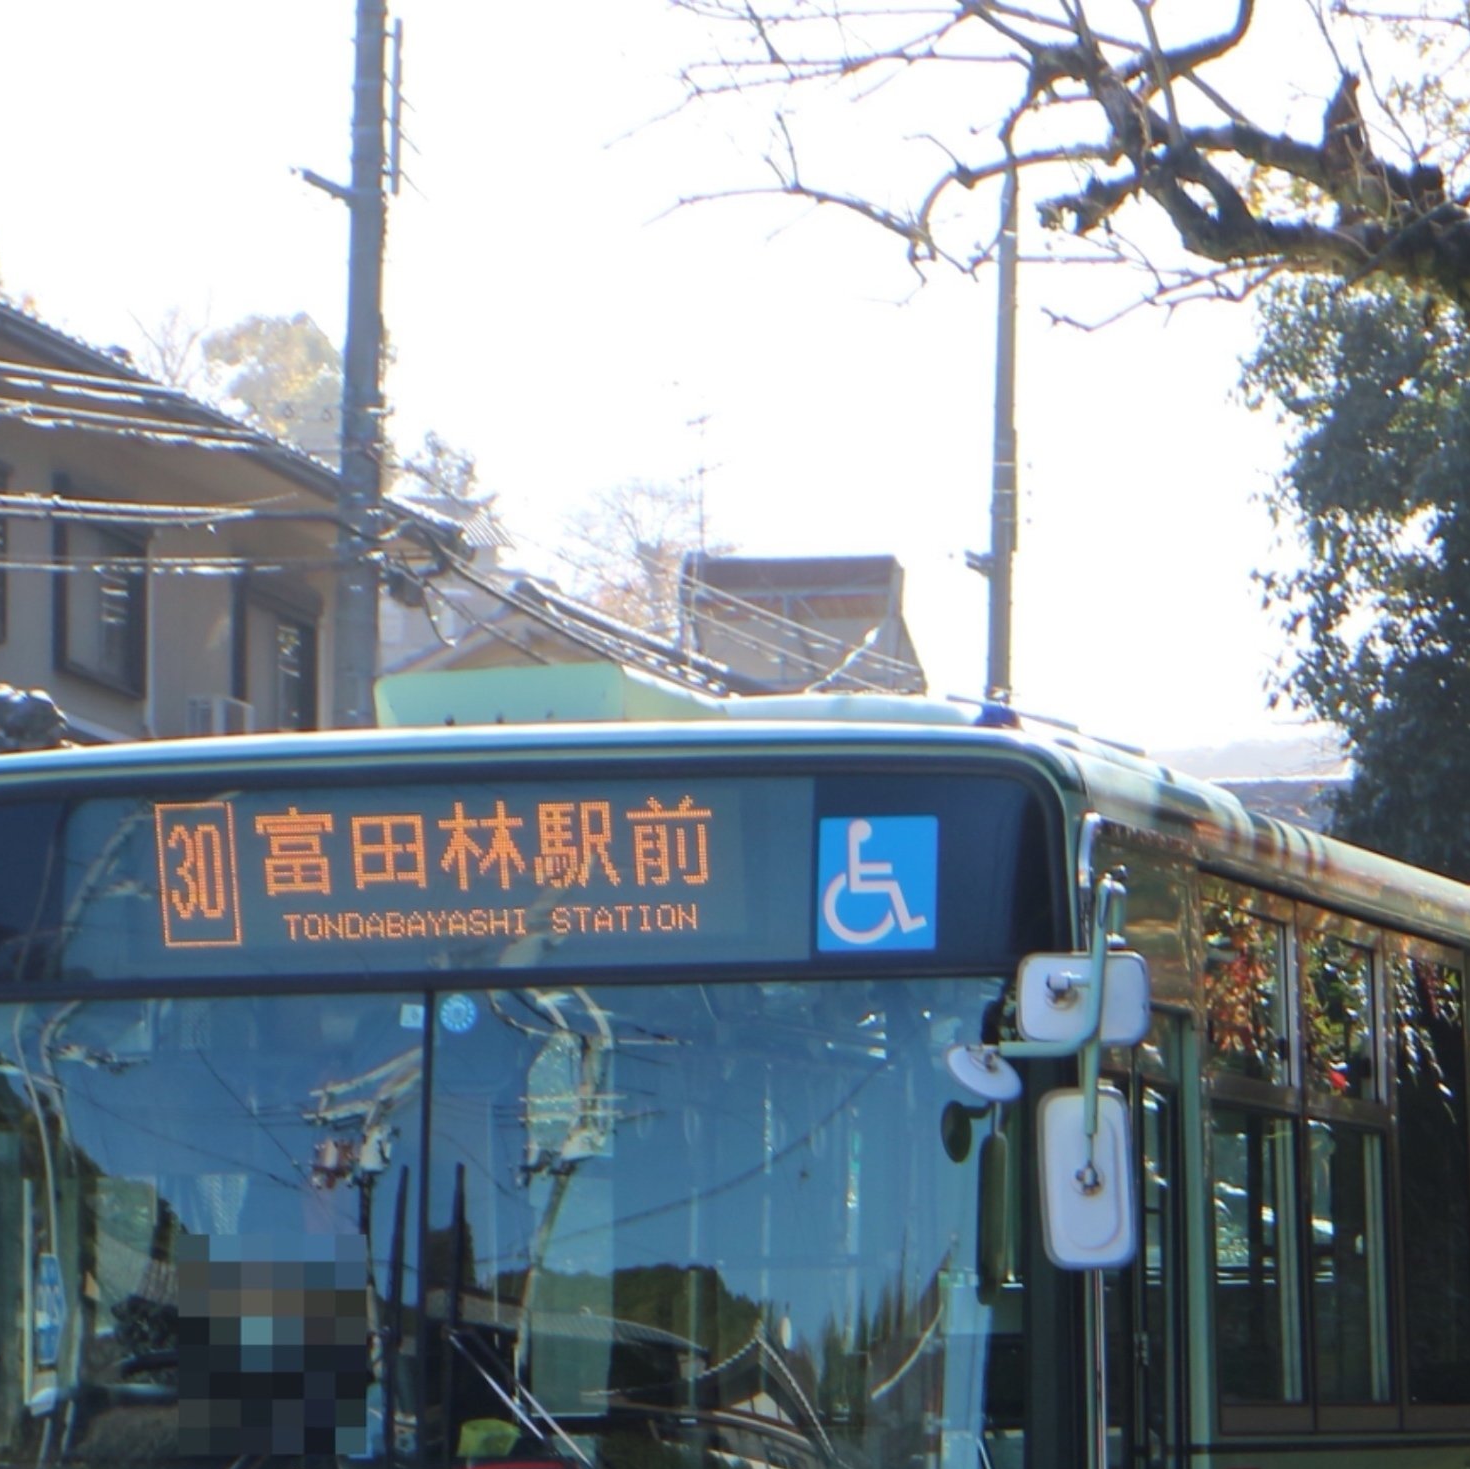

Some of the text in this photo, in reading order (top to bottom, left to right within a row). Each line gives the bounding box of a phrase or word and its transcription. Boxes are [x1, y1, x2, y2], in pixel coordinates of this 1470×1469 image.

[167, 823, 227, 921] 30
[254, 795, 714, 898] 富田林駅前
[283, 903, 699, 942] TONDABAYASHI STATION
